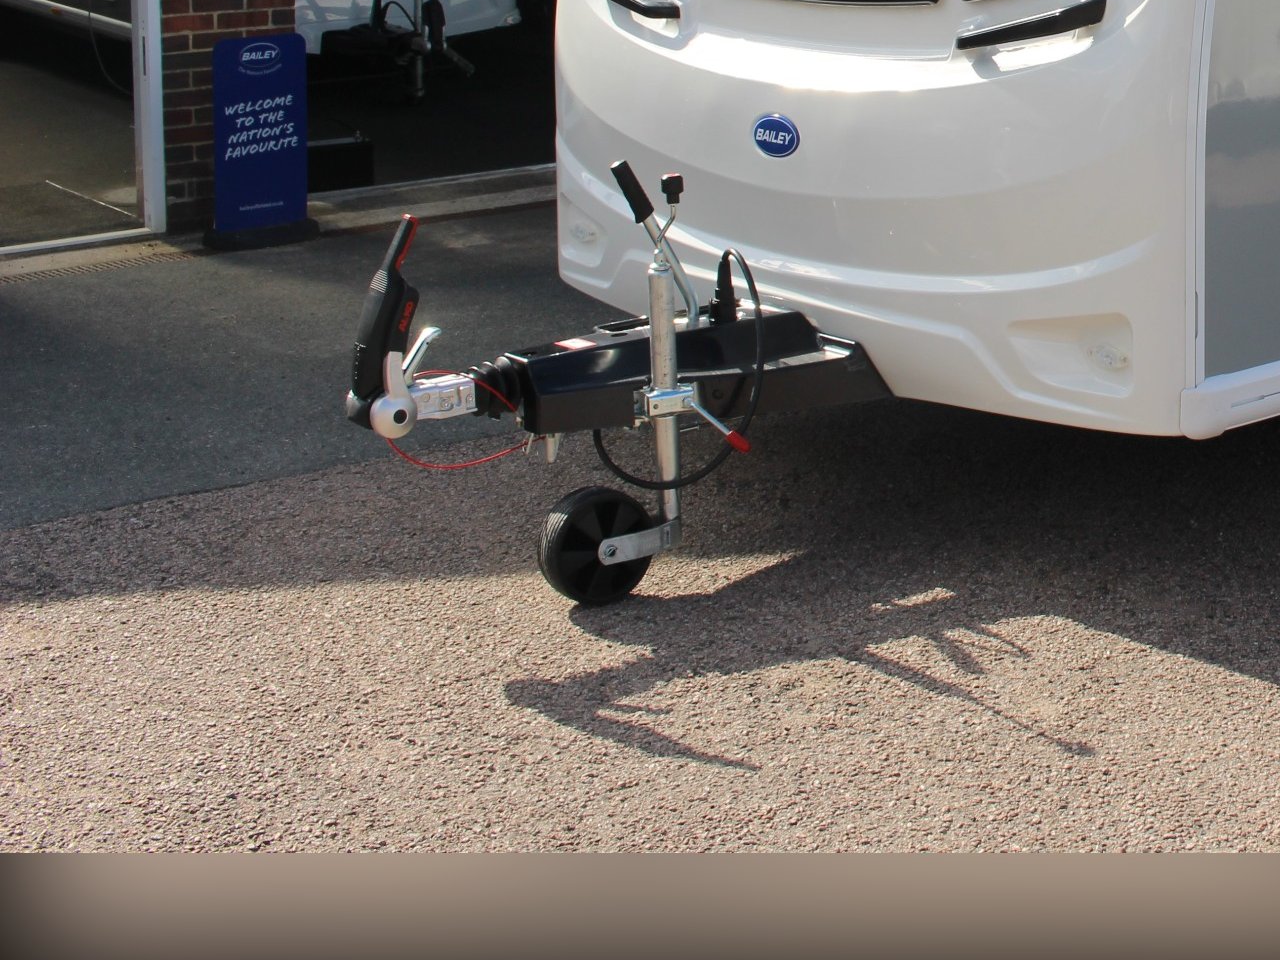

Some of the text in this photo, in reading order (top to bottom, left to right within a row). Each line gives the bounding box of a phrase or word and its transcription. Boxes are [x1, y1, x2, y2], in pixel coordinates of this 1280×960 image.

[241, 50, 279, 62] BAILEY
[224, 94, 294, 117] WELCOME
[235, 110, 285, 129] TO THE
[227, 123, 295, 145] NATION'S
[755, 128, 793, 145] BAILEY
[224, 135, 300, 161] FAVOURITE
